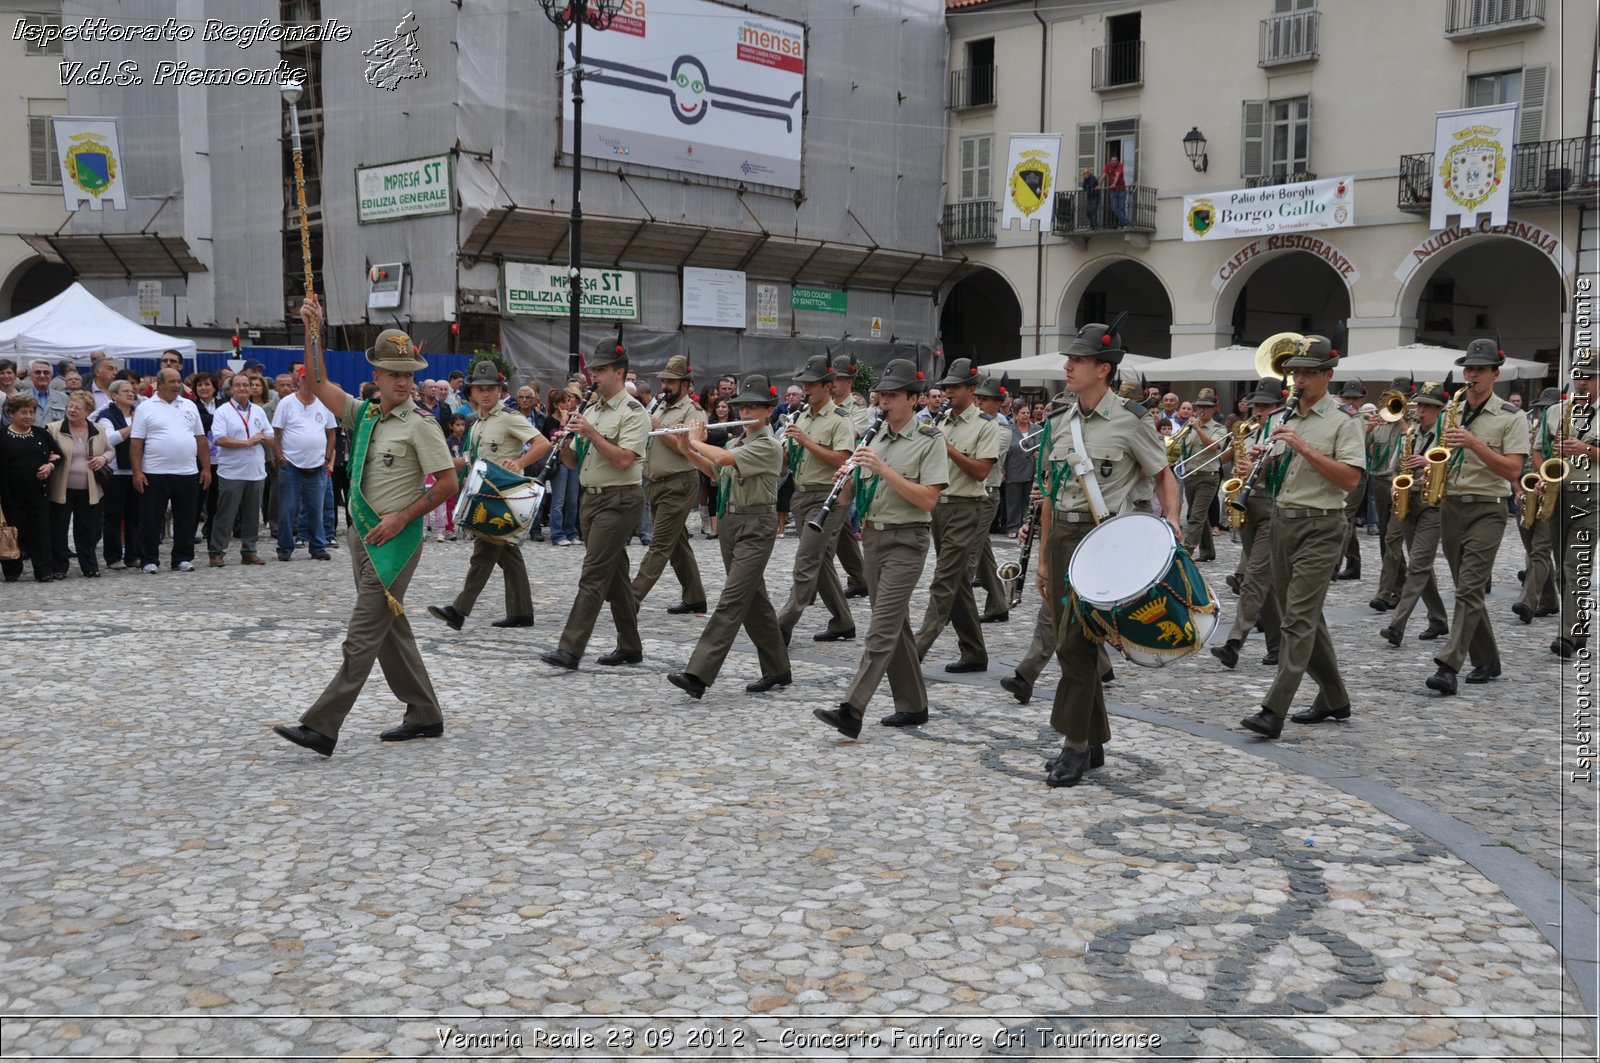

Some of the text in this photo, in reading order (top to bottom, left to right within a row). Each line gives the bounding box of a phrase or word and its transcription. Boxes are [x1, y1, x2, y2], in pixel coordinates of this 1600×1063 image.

[743, 28, 801, 56] mensa
[383, 162, 441, 191] IMPRESA ST
[362, 196, 397, 209] EDILIZIA
[400, 189, 447, 204] GENERALE
[1231, 186, 1315, 205] Palio dei Borghi
[1221, 199, 1326, 224] Borgo Gallo
[1265, 223, 1275, 232] 30
[1267, 235, 1354, 279] RISTORANTE
[602, 273, 622, 291] ST
[509, 289, 563, 303] EDILIZIA
[792, 290, 832, 300] UNITED COLORS
